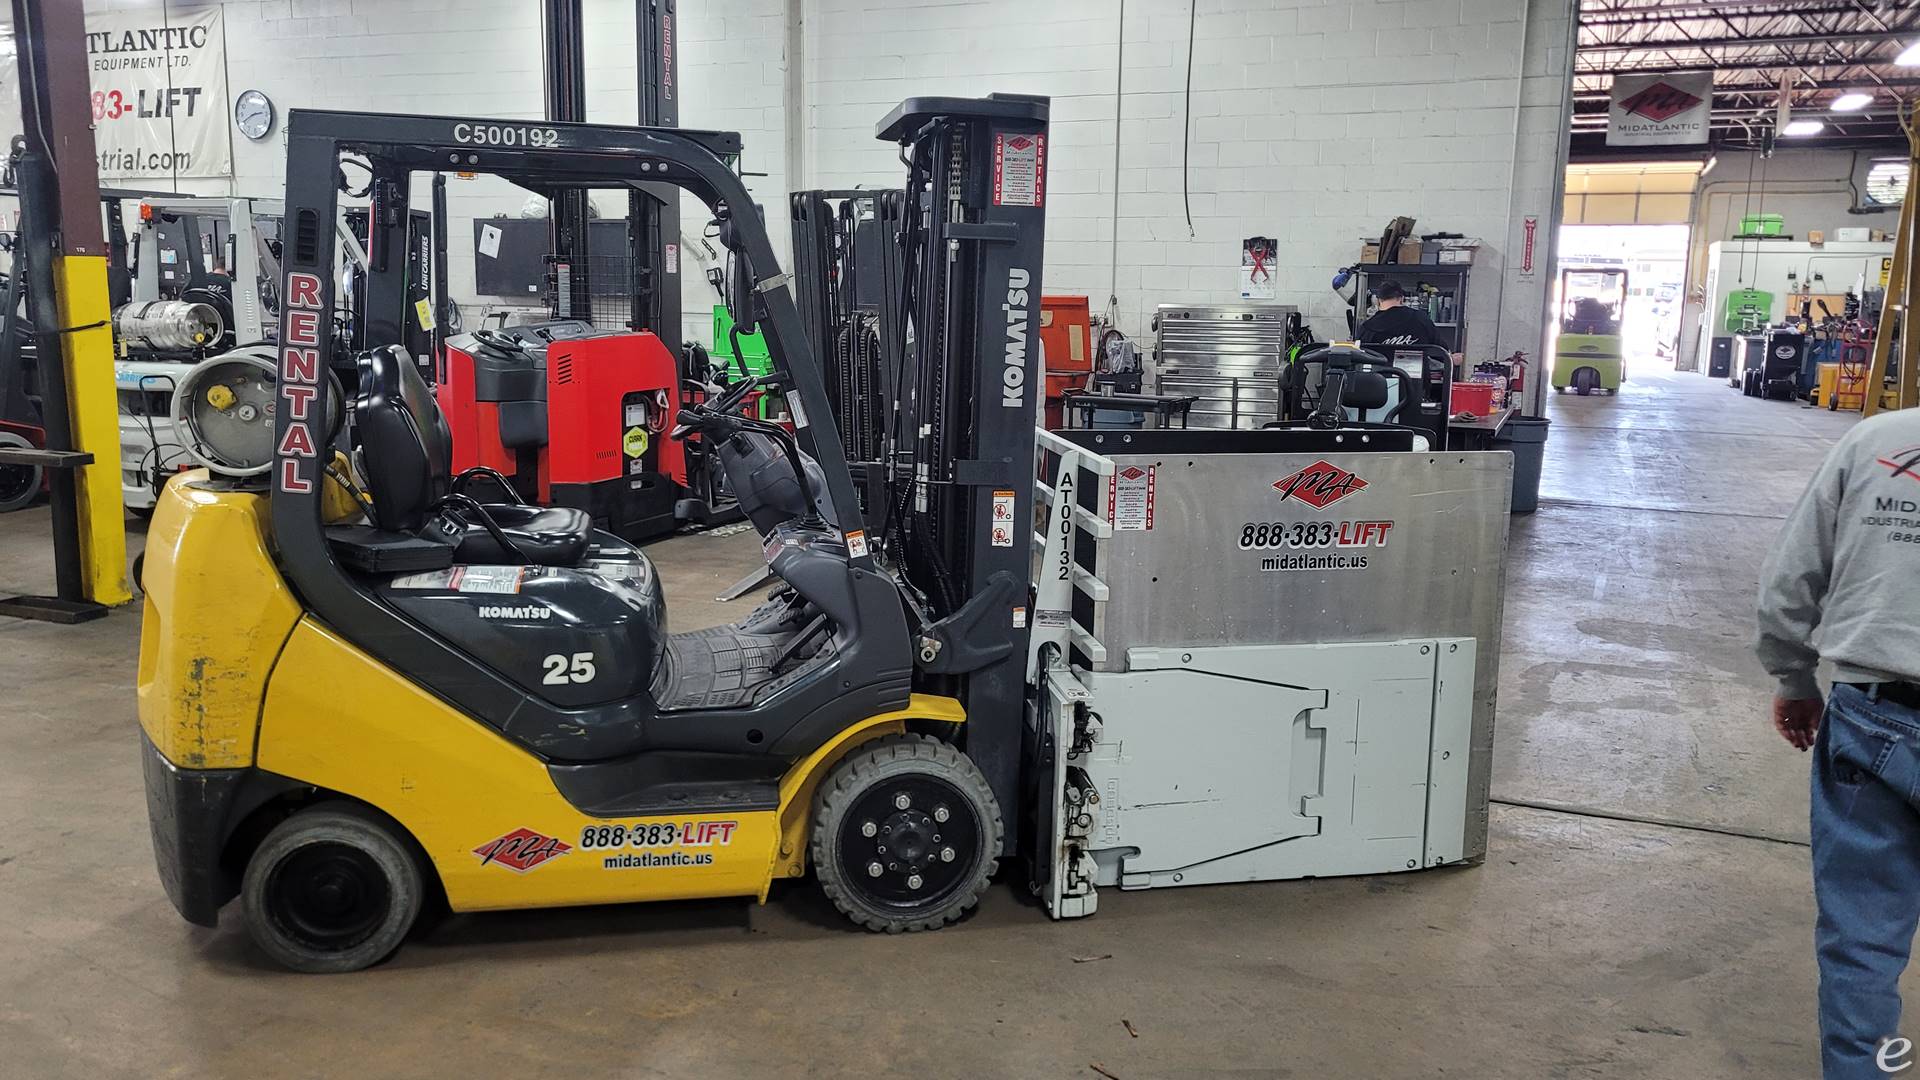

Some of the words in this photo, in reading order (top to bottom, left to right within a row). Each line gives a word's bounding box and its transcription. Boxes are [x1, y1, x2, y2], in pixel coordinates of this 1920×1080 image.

[94, 56, 163, 71] EQUIPMENT
[663, 15, 672, 100] RENTAL
[453, 123, 560, 148] C500192
[1036, 137, 1044, 203] RENTALS
[1002, 267, 1030, 408] KOMATSU
[279, 272, 323, 494] RENTAL
[1058, 472, 1073, 581] AT00132
[1261, 553, 1368, 570] midatlantic.us
[479, 605, 551, 619] KOMATSU
[542, 652, 596, 685] 25
[604, 852, 713, 868] midatlantic.us
